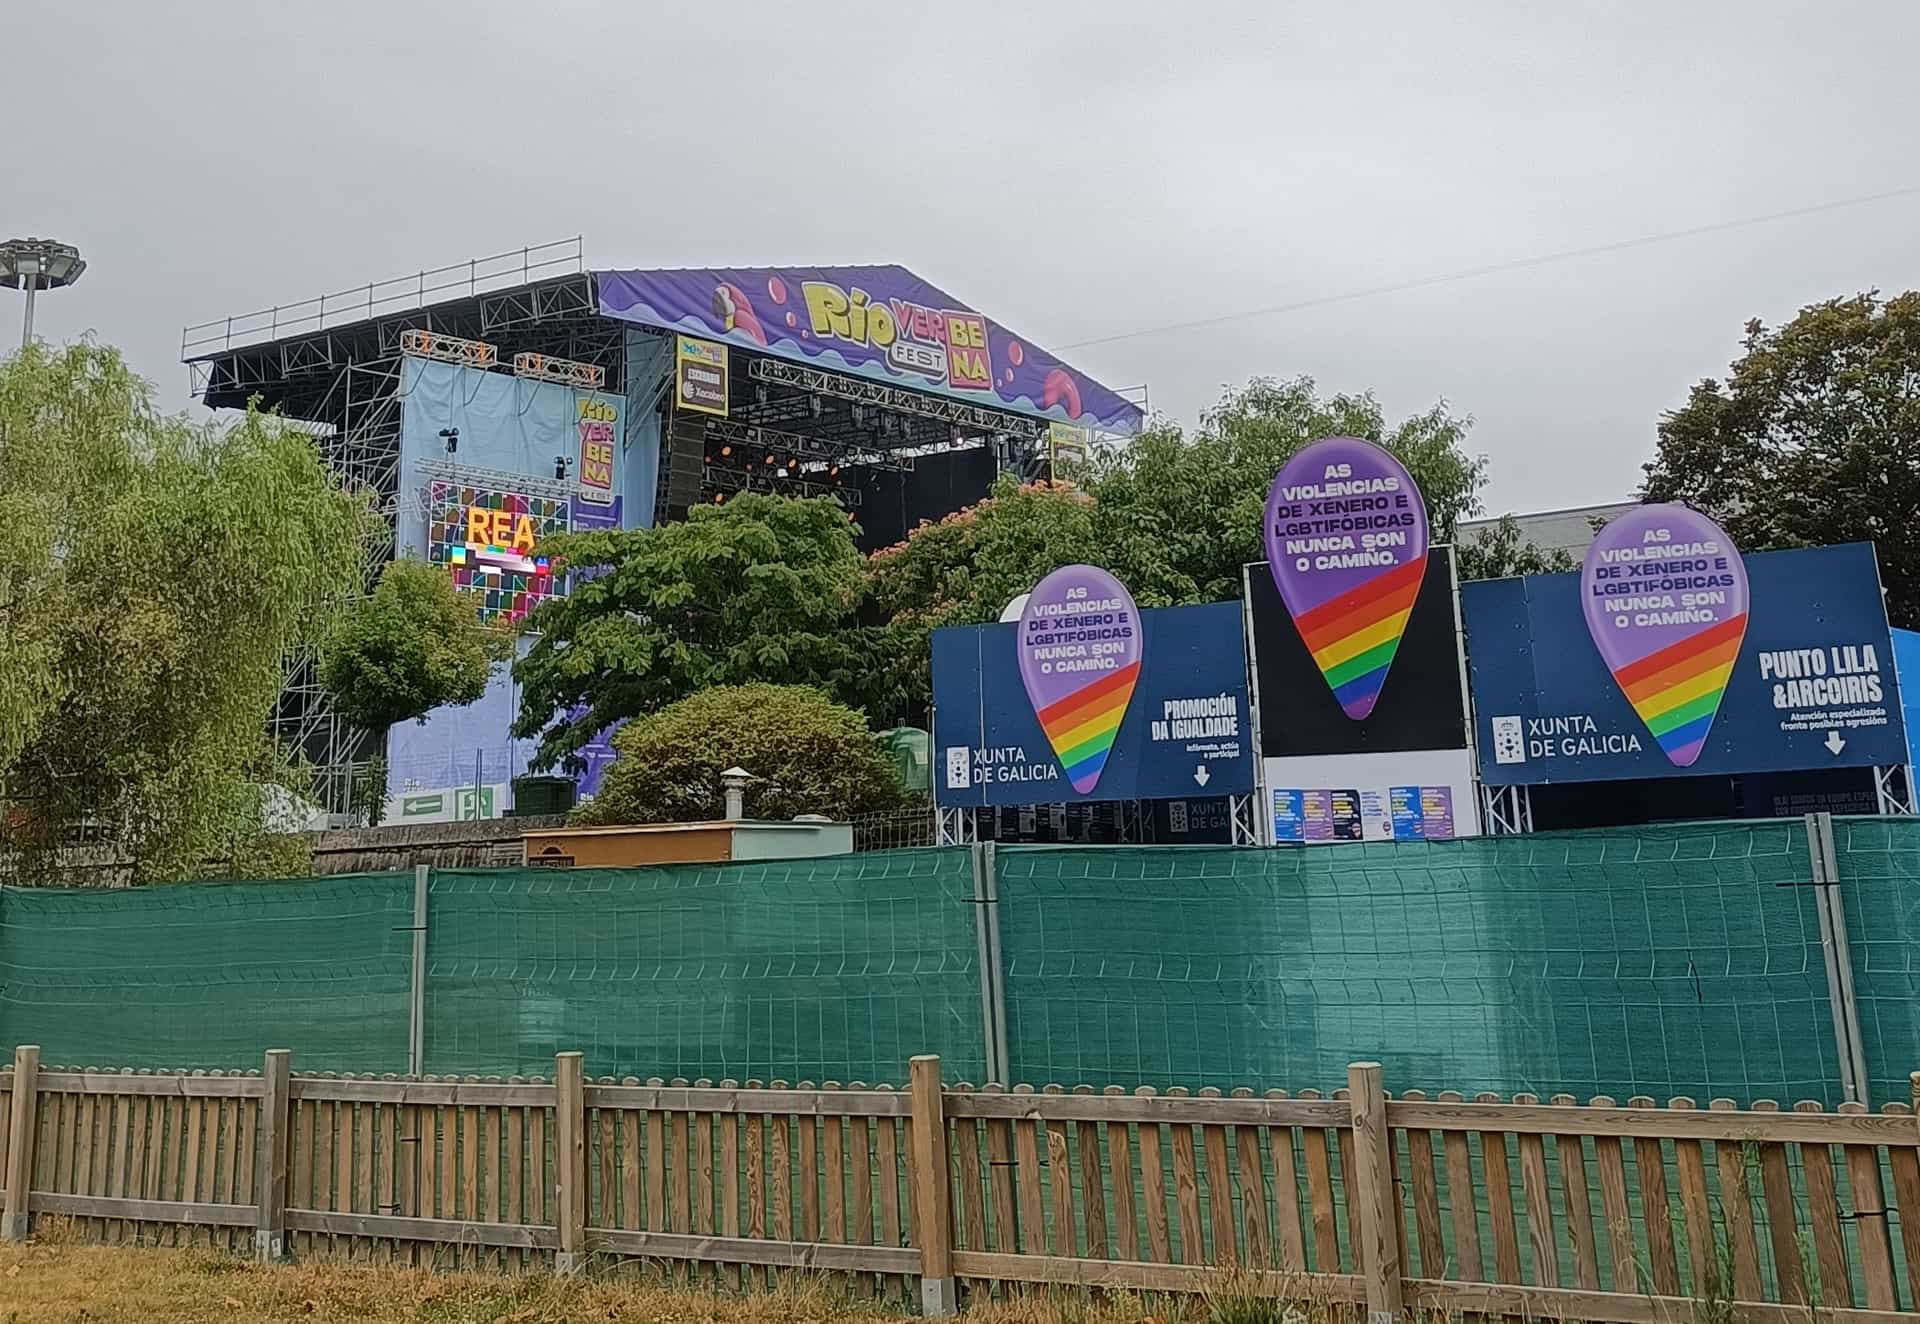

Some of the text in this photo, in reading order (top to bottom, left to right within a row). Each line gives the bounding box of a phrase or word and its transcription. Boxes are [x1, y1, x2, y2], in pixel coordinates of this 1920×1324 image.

[890, 299, 945, 344] VER
[949, 318, 985, 348] BE
[896, 346, 942, 367] FEST
[951, 351, 990, 381] NA
[587, 443, 612, 464] BE
[585, 462, 610, 483] NA
[1324, 464, 1352, 479] AS
[1282, 477, 1399, 501] VIOLENCIAS
[1278, 495, 1408, 519] DE XÉNERO E
[467, 507, 536, 549] REA
[1275, 512, 1415, 537] LGBTIFÓBICAS
[1286, 531, 1405, 555] NUNCA SON
[1643, 529, 1671, 543] AS
[1296, 548, 1399, 572] O CAMIÑO.
[1600, 541, 1719, 562] VIOLENCIAS
[1596, 557, 1728, 579] DE XÉNERO E
[1066, 587, 1087, 599] AS
[1593, 574, 1734, 596] LGBTIFÓBICAS
[1034, 598, 1122, 616] VIOLENCIAS
[1605, 591, 1725, 612] NUNCA SON
[1029, 612, 1128, 631] DE XÉNERO E
[1615, 607, 1719, 628] O CAMIÑO.
[1026, 627, 1132, 646] LGBTIFÓBICAS
[1034, 642, 1125, 660] NUNCA SON
[1041, 655, 1119, 673] O CAMIÑO.
[1759, 644, 1879, 680] PUNTO LILA
[1773, 674, 1883, 709] &ARCOIRIS
[1164, 691, 1237, 720] PROMOCIÓN
[1791, 707, 1886, 721] Atención especializada
[1151, 717, 1239, 741] DA IGUALDADE
[1528, 715, 1598, 737] XUNTA
[1809, 719, 1844, 731] posibles
[973, 747, 1026, 765] XUNTA
[1530, 734, 1642, 758] DE GALICIA
[974, 764, 1058, 784] DE GALICIA
[1191, 817, 1207, 829] DE
